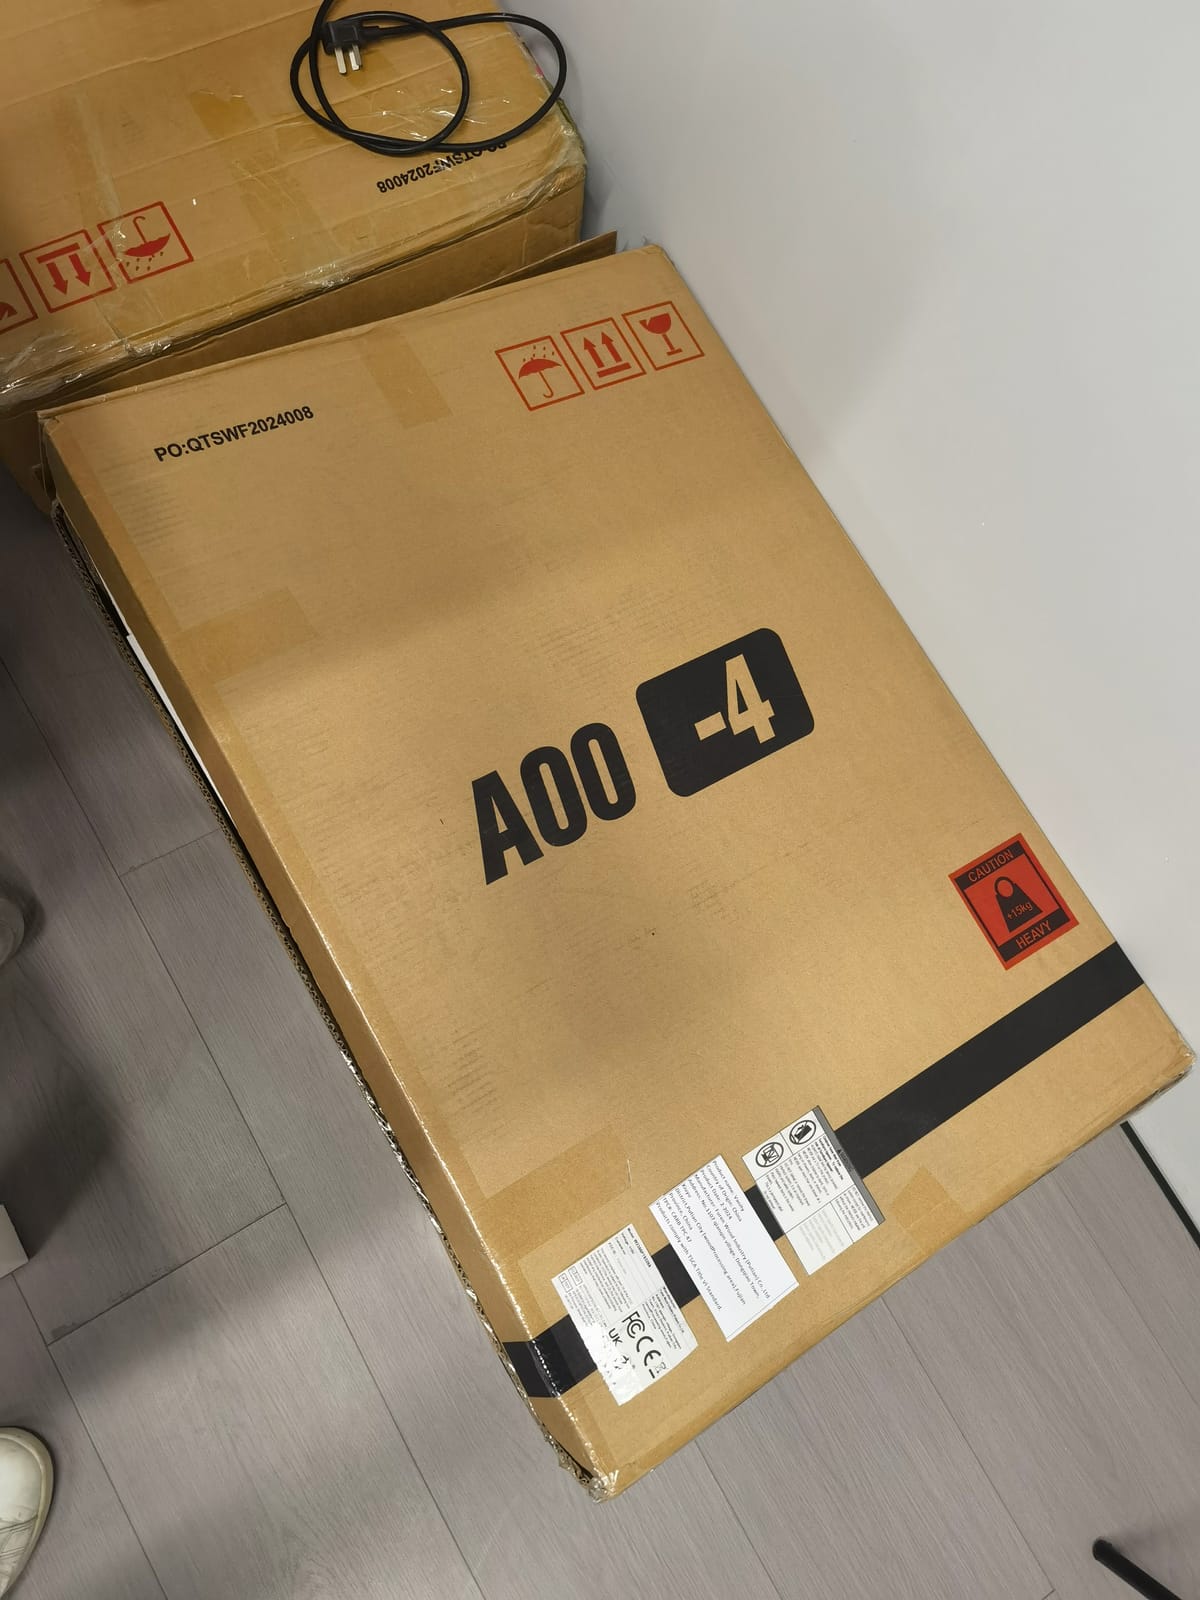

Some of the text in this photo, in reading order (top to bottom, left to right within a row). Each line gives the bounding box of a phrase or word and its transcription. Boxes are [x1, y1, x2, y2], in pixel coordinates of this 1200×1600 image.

[153, 405, 314, 462] PO:QTSWF2024008
[967, 849, 1014, 883] CAUTION
[1015, 919, 1052, 950] HEAVY
